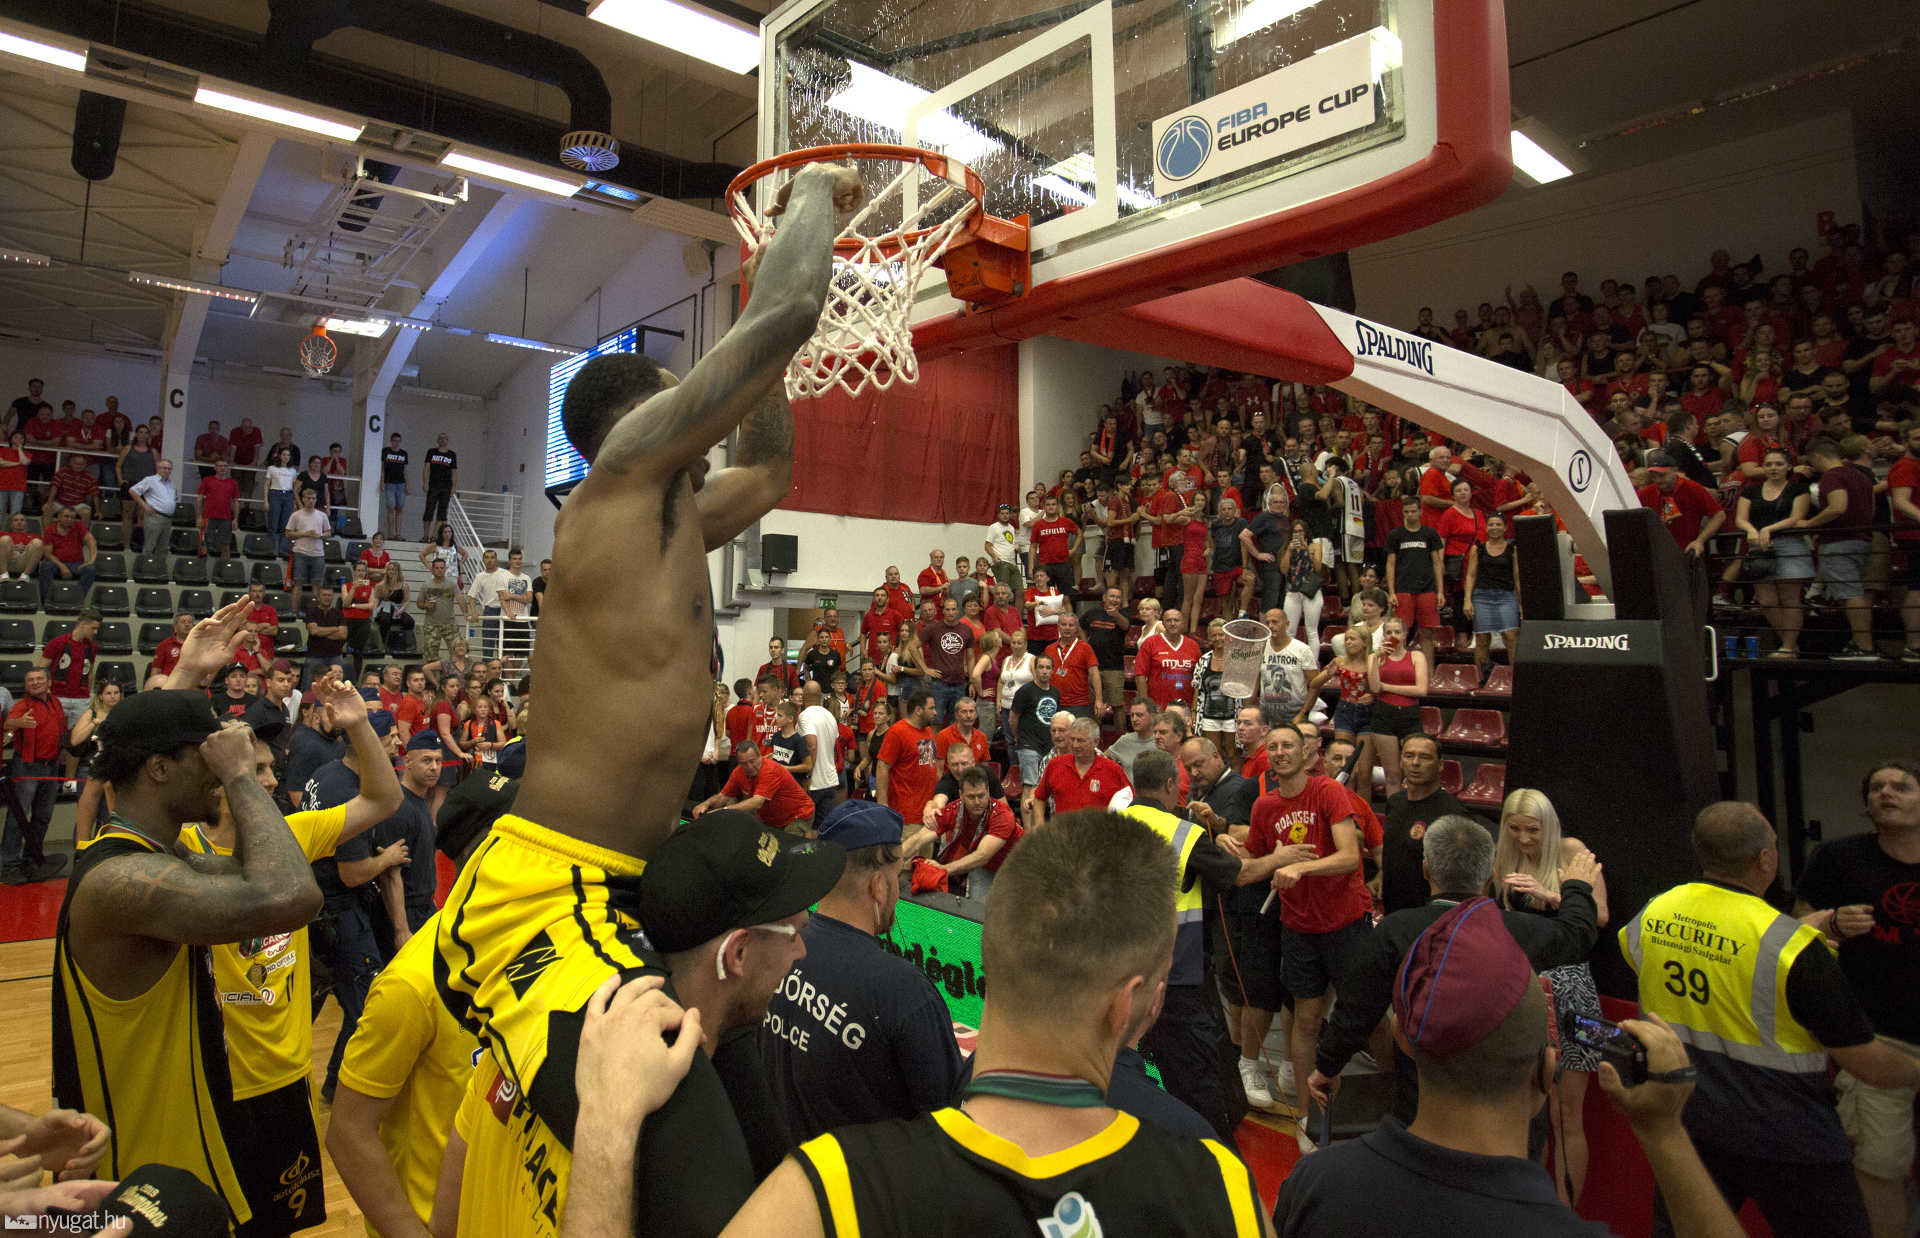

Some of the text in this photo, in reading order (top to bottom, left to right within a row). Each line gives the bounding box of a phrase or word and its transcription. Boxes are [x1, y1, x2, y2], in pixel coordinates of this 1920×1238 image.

[1216, 101, 1268, 134] FIBA
[1217, 83, 1369, 151] EUROPE CUP
[1356, 319, 1433, 376] SPALDING
[170, 388, 184, 409] C
[369, 414, 381, 433] C
[1543, 633, 1629, 651] SPALDING
[1268, 655, 1297, 666] PATRON
[1645, 917, 1747, 957] SECURITY
[1673, 912, 1717, 931] Metropolis
[1663, 960, 1710, 1006] 39
[289, 1187, 307, 1218] 9
